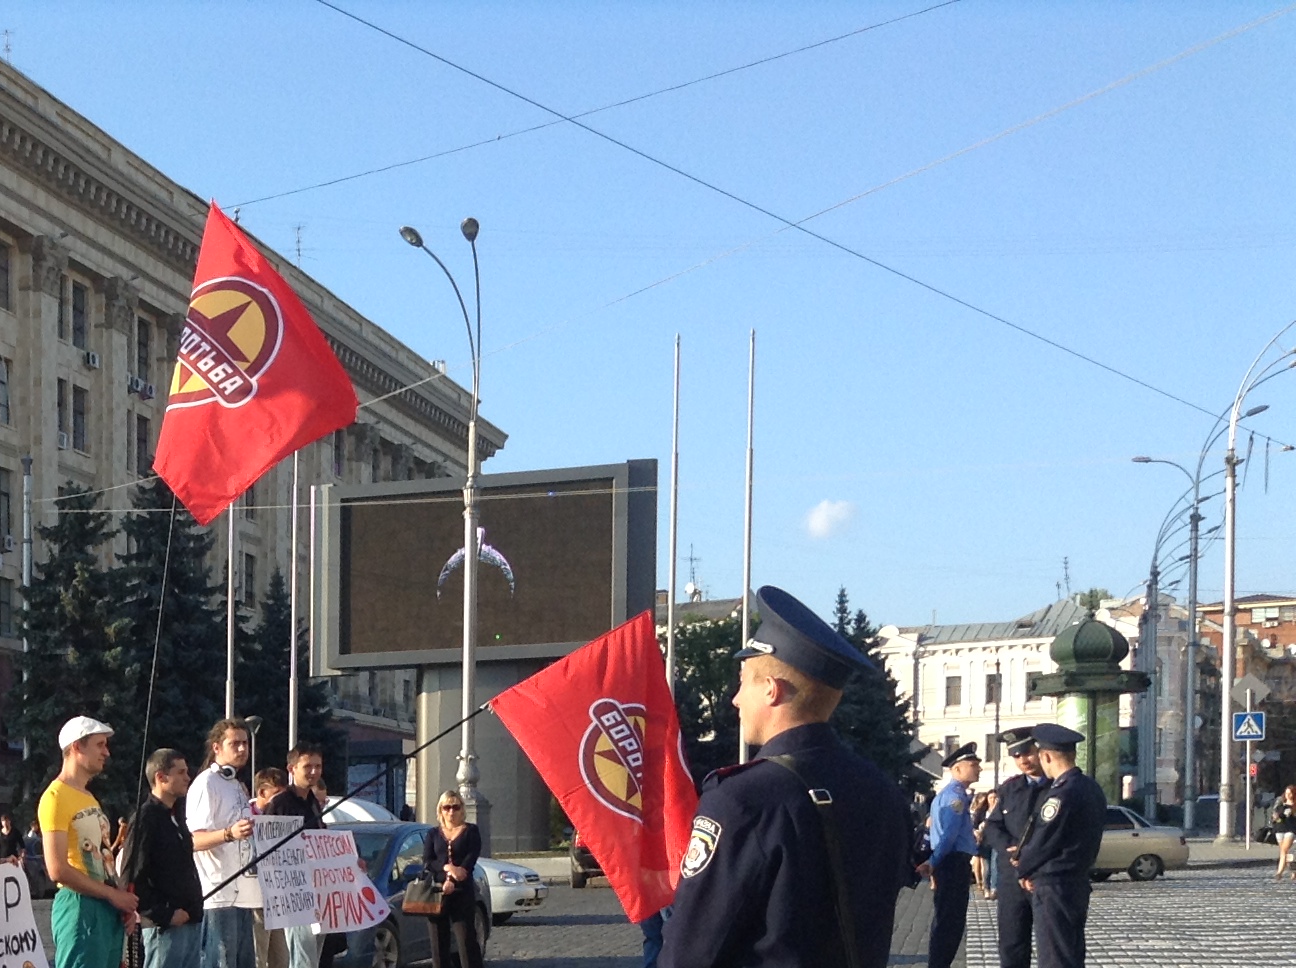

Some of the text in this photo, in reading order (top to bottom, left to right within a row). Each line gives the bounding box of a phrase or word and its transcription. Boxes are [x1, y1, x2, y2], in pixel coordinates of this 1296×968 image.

[600, 710, 643, 778] БОРО
[313, 866, 355, 888] ПРОТИВ
[316, 886, 384, 929] ИРИИ!
